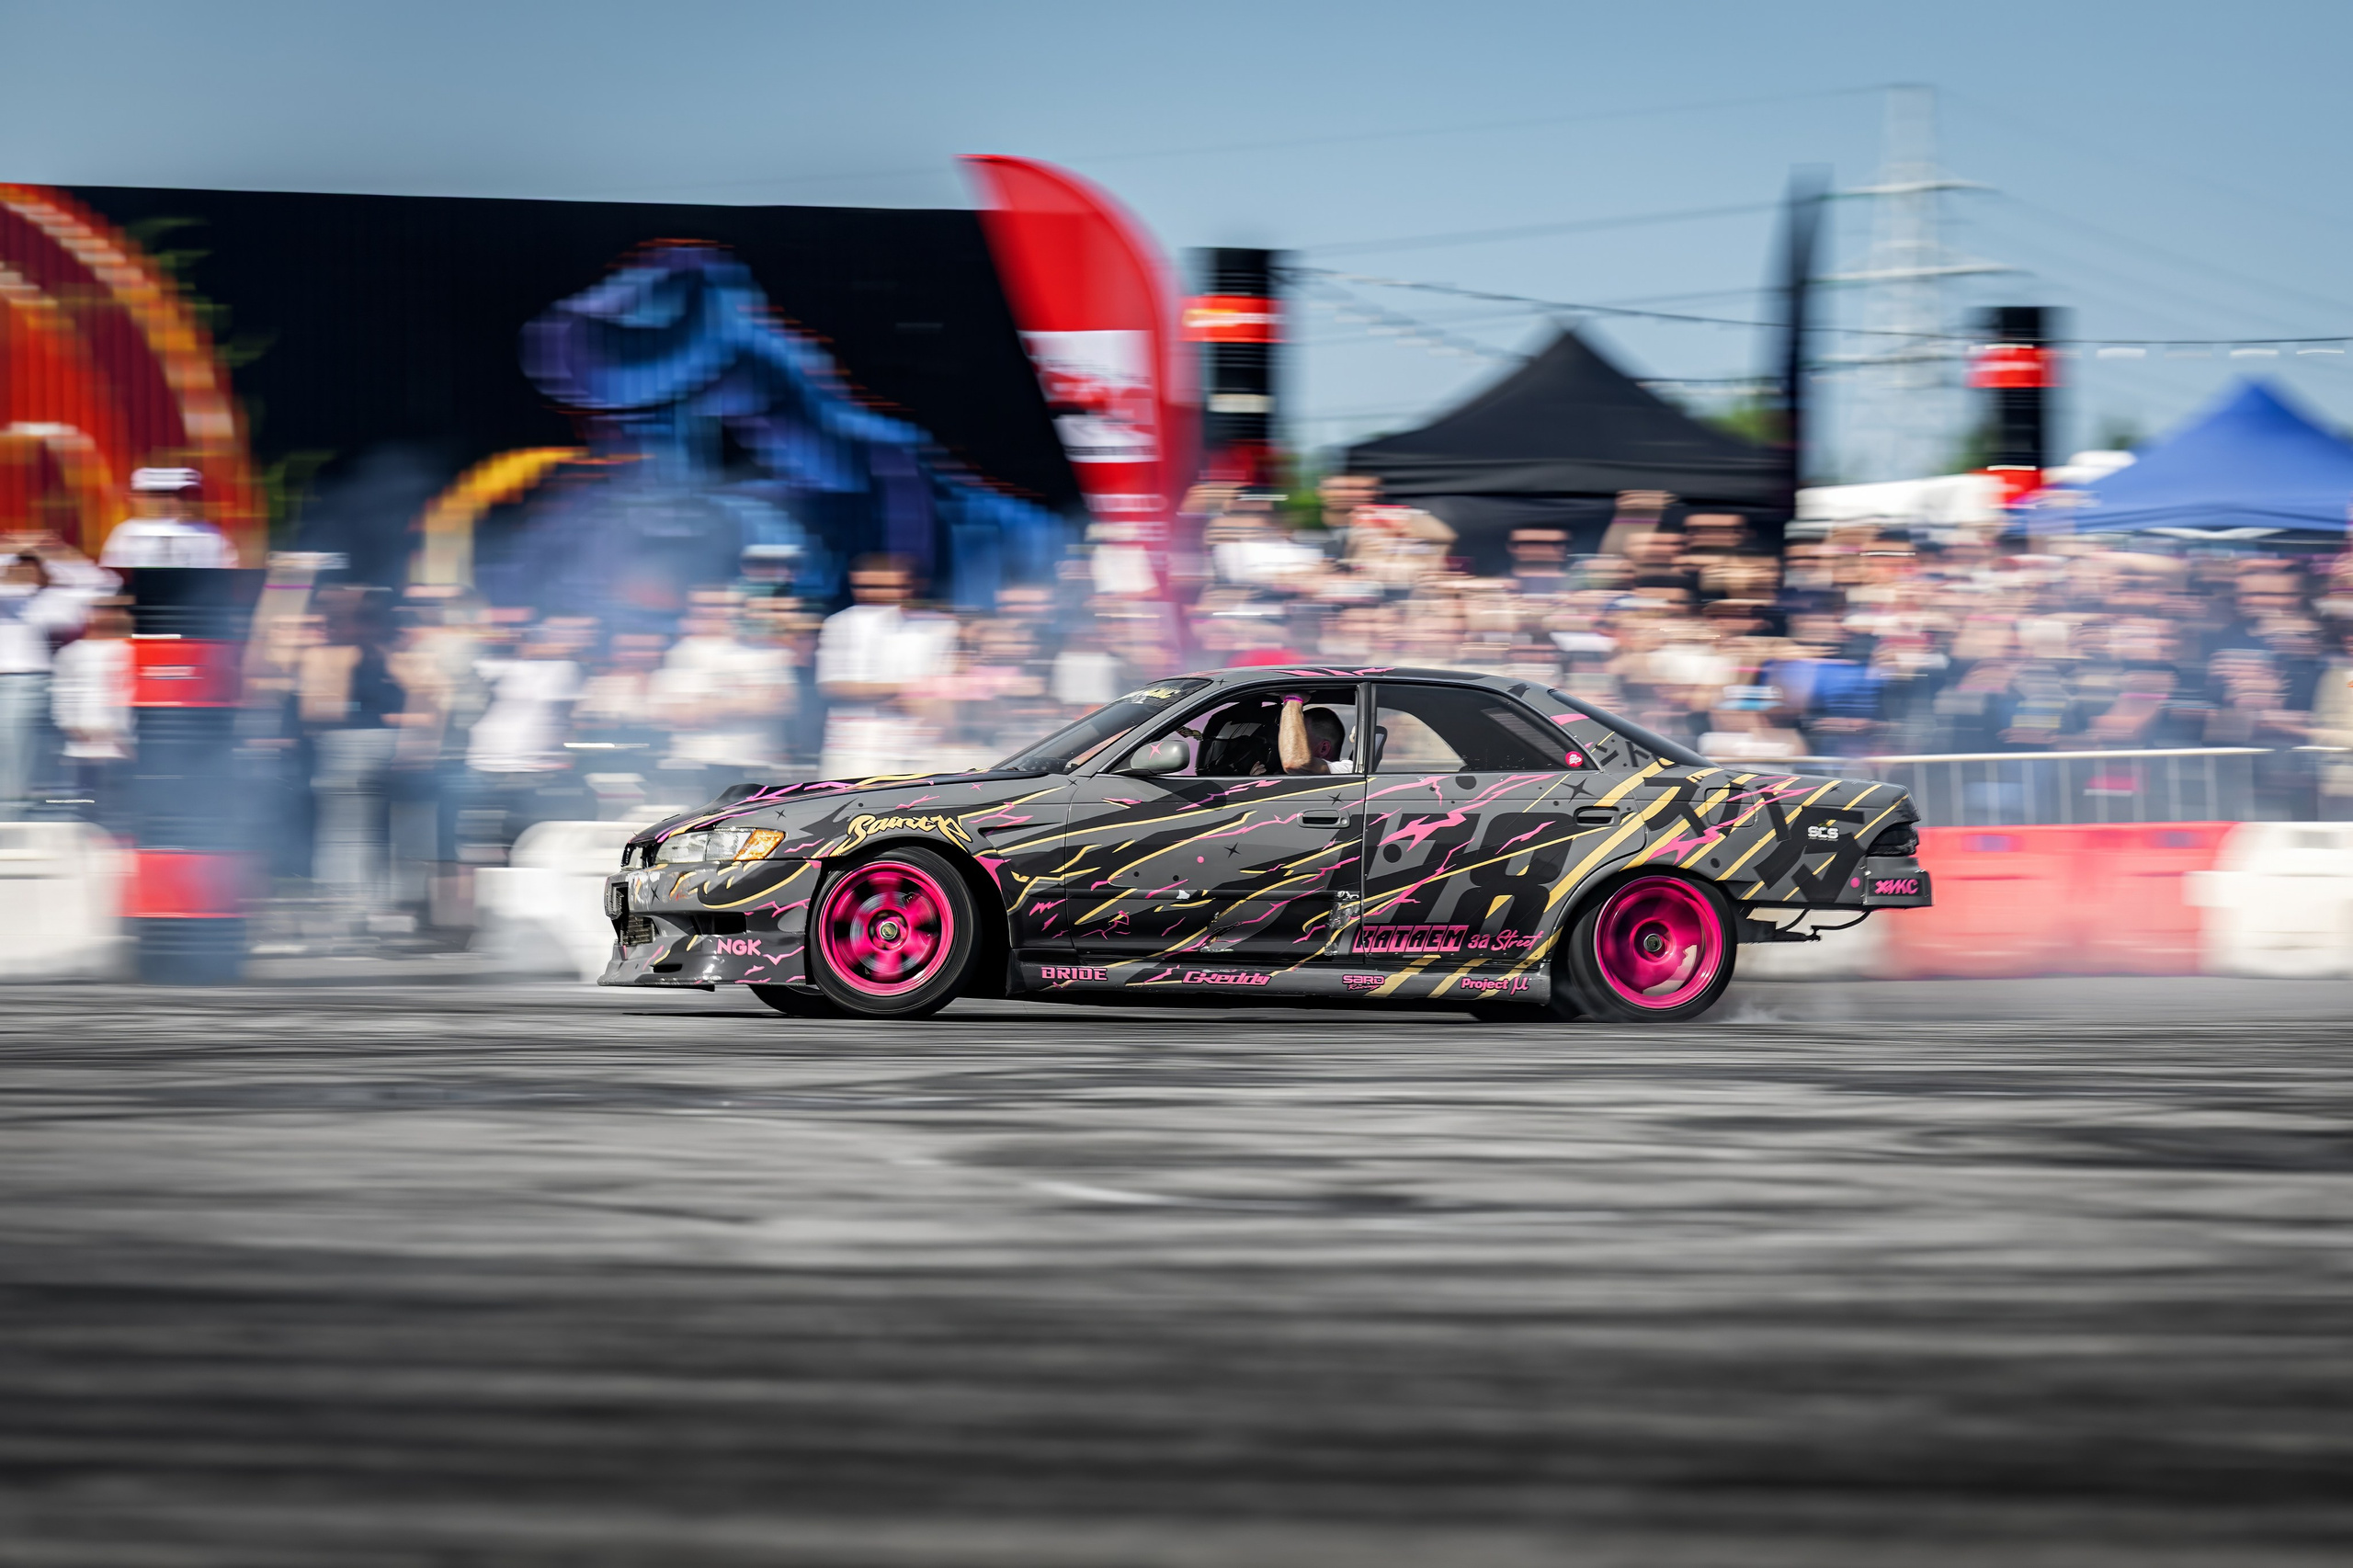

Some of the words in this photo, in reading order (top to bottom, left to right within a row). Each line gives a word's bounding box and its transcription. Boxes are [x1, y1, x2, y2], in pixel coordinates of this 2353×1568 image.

[1807, 825, 1838, 839] SCS
[717, 937, 762, 956] NGK
[1490, 929, 1544, 951] Street
[1040, 966, 1108, 981] BRIDE
[1461, 977, 1509, 992] Project
